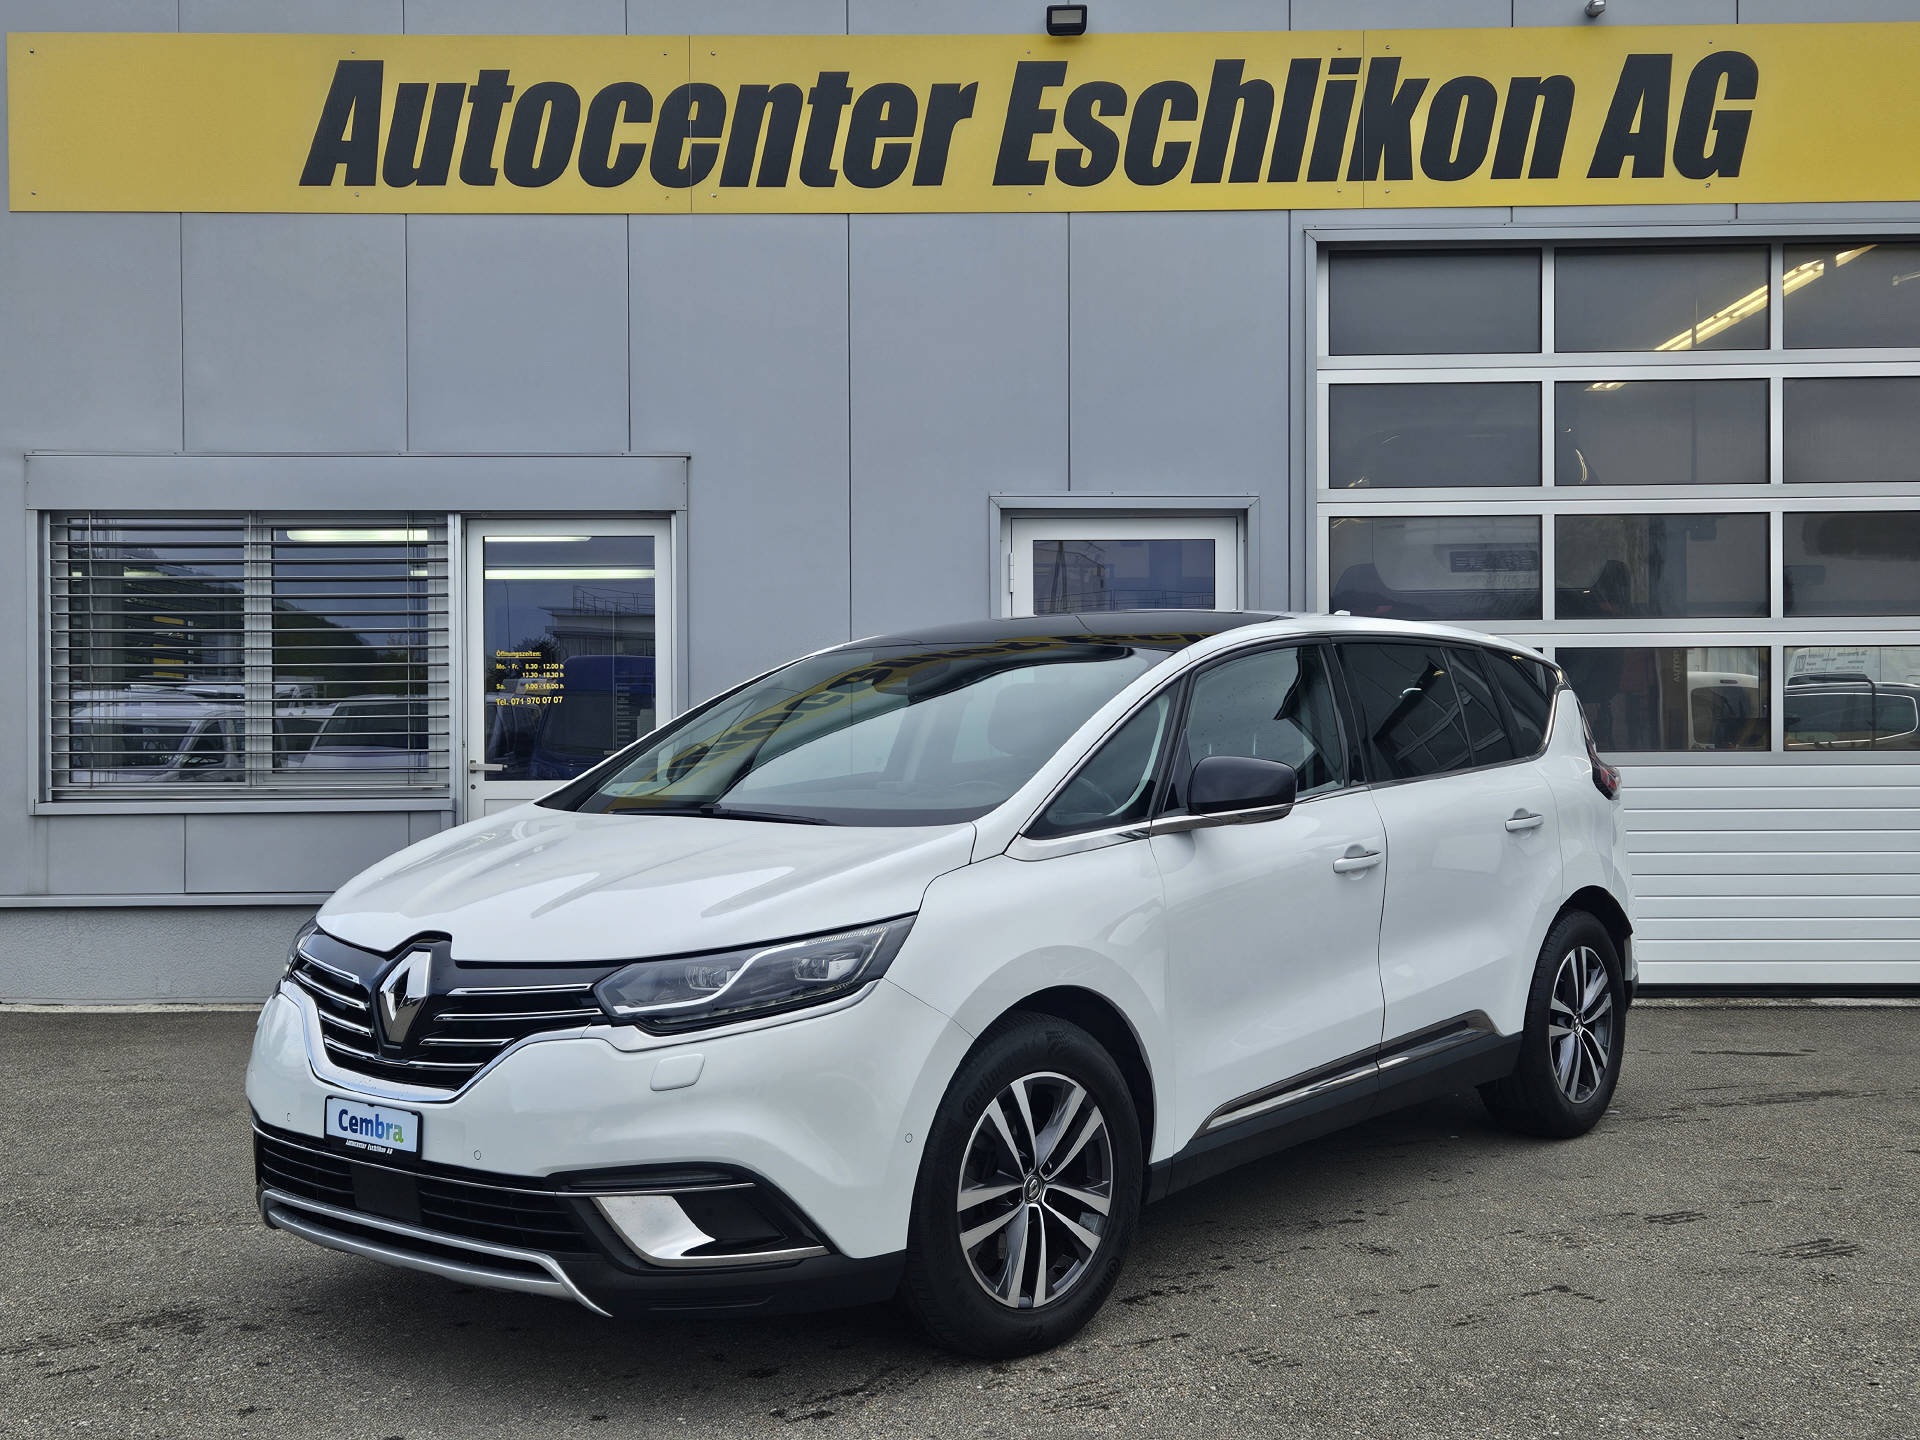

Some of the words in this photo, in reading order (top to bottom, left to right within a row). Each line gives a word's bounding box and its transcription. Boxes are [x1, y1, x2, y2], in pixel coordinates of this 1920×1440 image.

[298, 60, 978, 188] Autocenter
[992, 56, 1576, 187] Eschlikon
[1587, 51, 1758, 180] AG
[496, 698, 509, 706] Tel.
[511, 697, 524, 706] 071
[526, 697, 541, 705] 970
[553, 696, 563, 704] 07
[338, 1108, 404, 1144] Cembra
